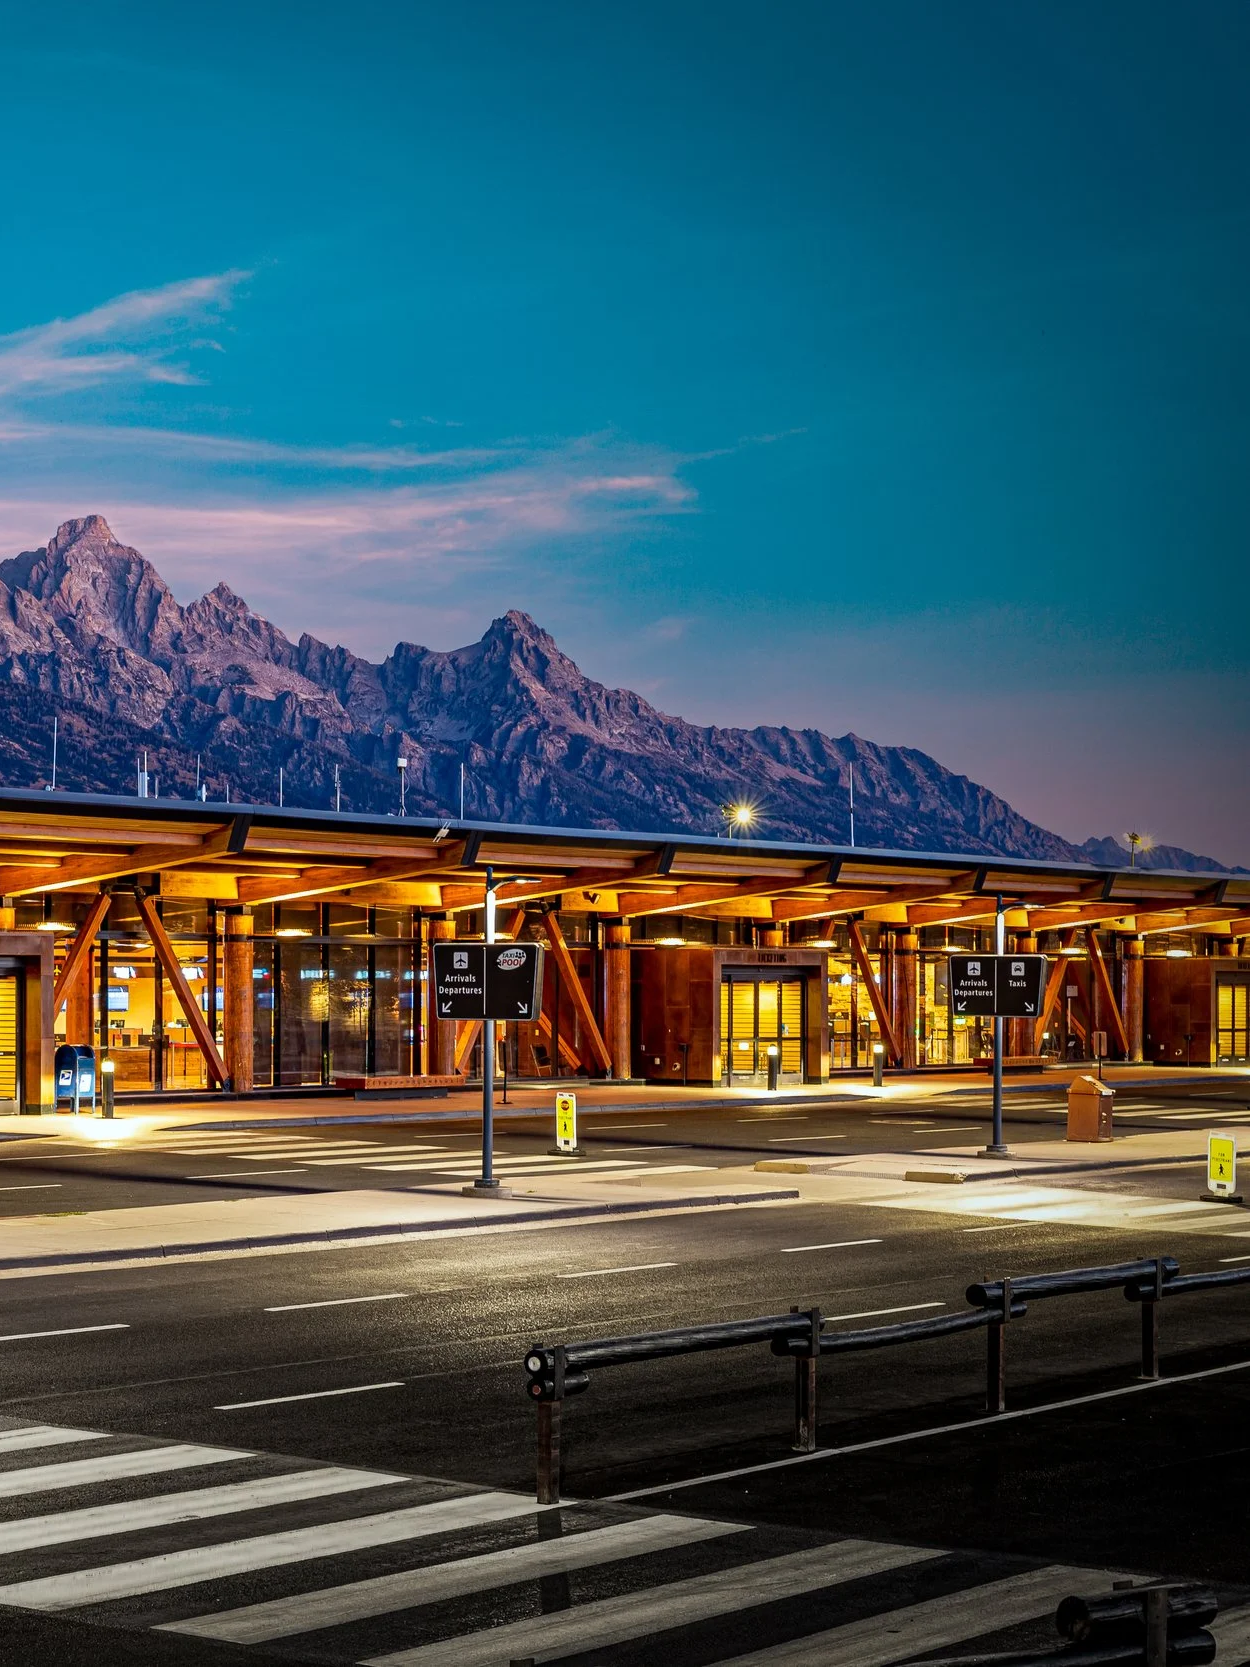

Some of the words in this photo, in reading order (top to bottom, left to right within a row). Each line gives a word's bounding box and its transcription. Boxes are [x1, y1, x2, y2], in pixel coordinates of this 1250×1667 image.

[445, 974, 476, 982] Arrivals
[960, 979, 988, 987] Arrivals
[438, 986, 482, 996] Departures
[954, 989, 993, 997] Departures
